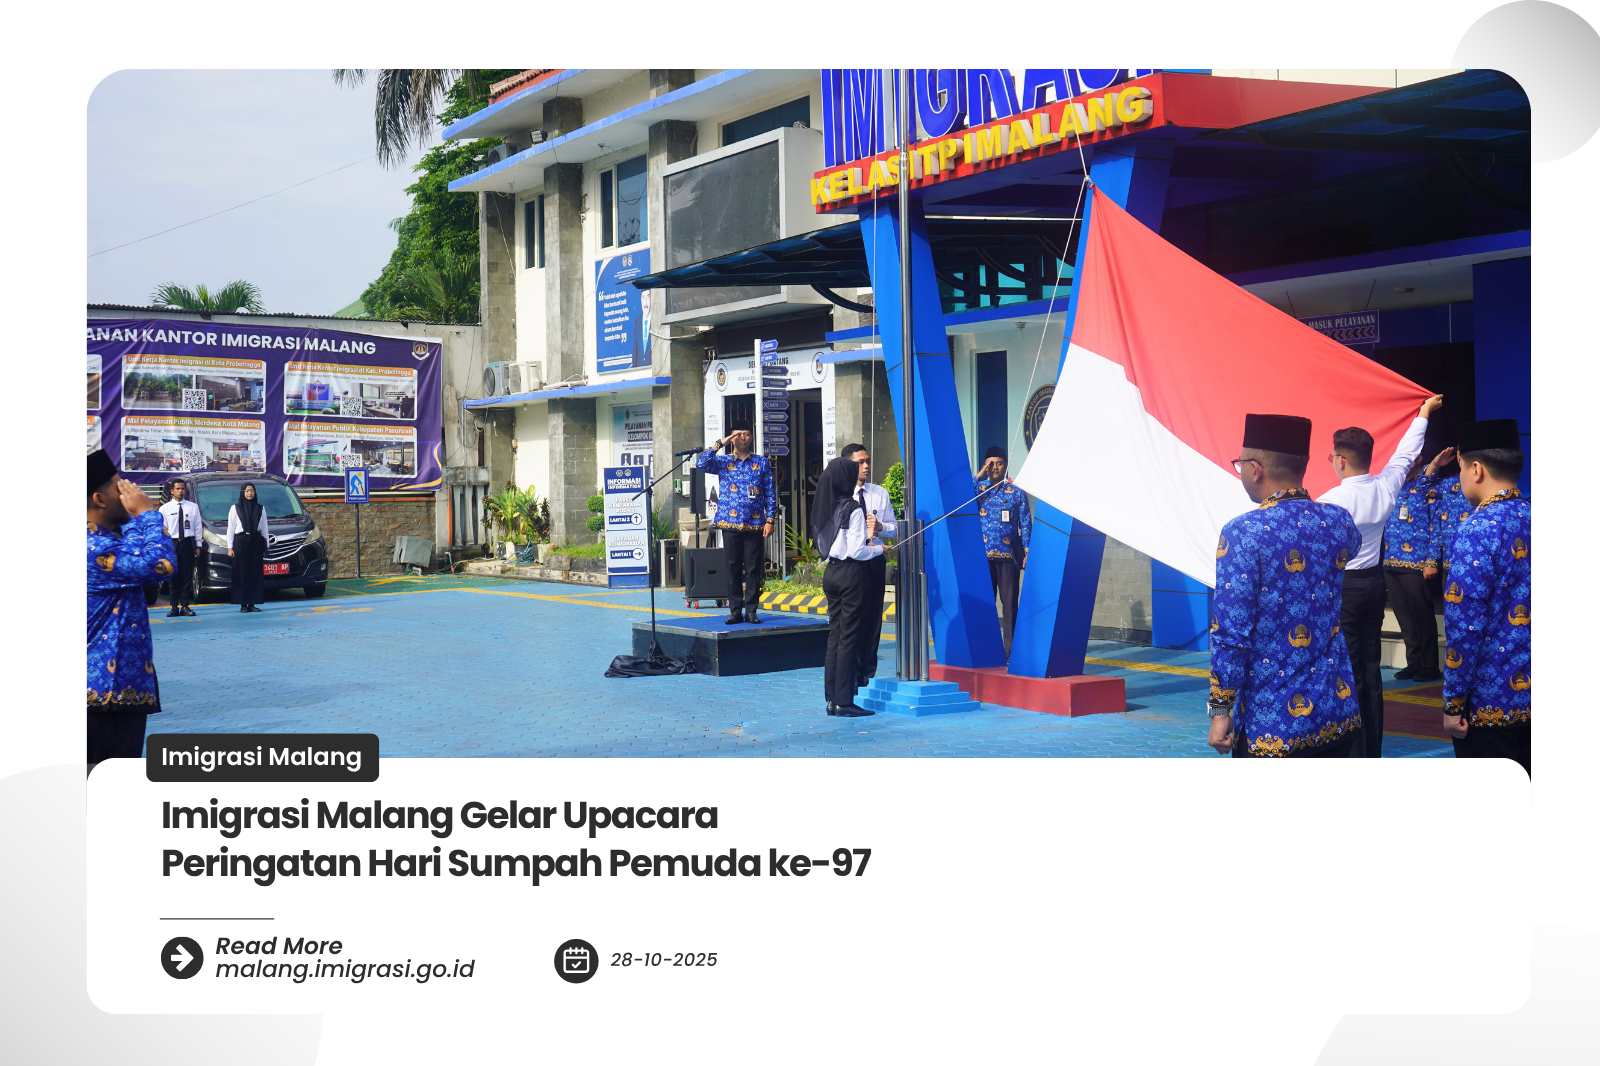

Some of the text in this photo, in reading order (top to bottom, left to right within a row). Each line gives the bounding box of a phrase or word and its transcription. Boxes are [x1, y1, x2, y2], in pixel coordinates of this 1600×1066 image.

[810, 155, 900, 206] KELAS
[917, 133, 976, 176] TPI
[976, 86, 1150, 161] MALANG
[1308, 314, 1376, 329] MASUK PELAYANAN
[142, 328, 217, 346] KANTOR
[221, 333, 300, 350] IMIGRASI
[304, 337, 376, 355] MALANG
[141, 356, 157, 364] Kerja
[179, 358, 204, 366] Imigrasi
[225, 361, 261, 369] Probolinggo
[336, 366, 359, 374] Imigrasi
[378, 368, 412, 377] Probolinggo
[140, 417, 173, 426] Pelayanan
[237, 421, 260, 429] Malang
[300, 423, 332, 431] Pelayanan
[332, 424, 352, 432] Publik
[352, 425, 384, 433] Kabupaten
[624, 421, 648, 431] PELAYANAN
[628, 431, 649, 441] KELOMPOK
